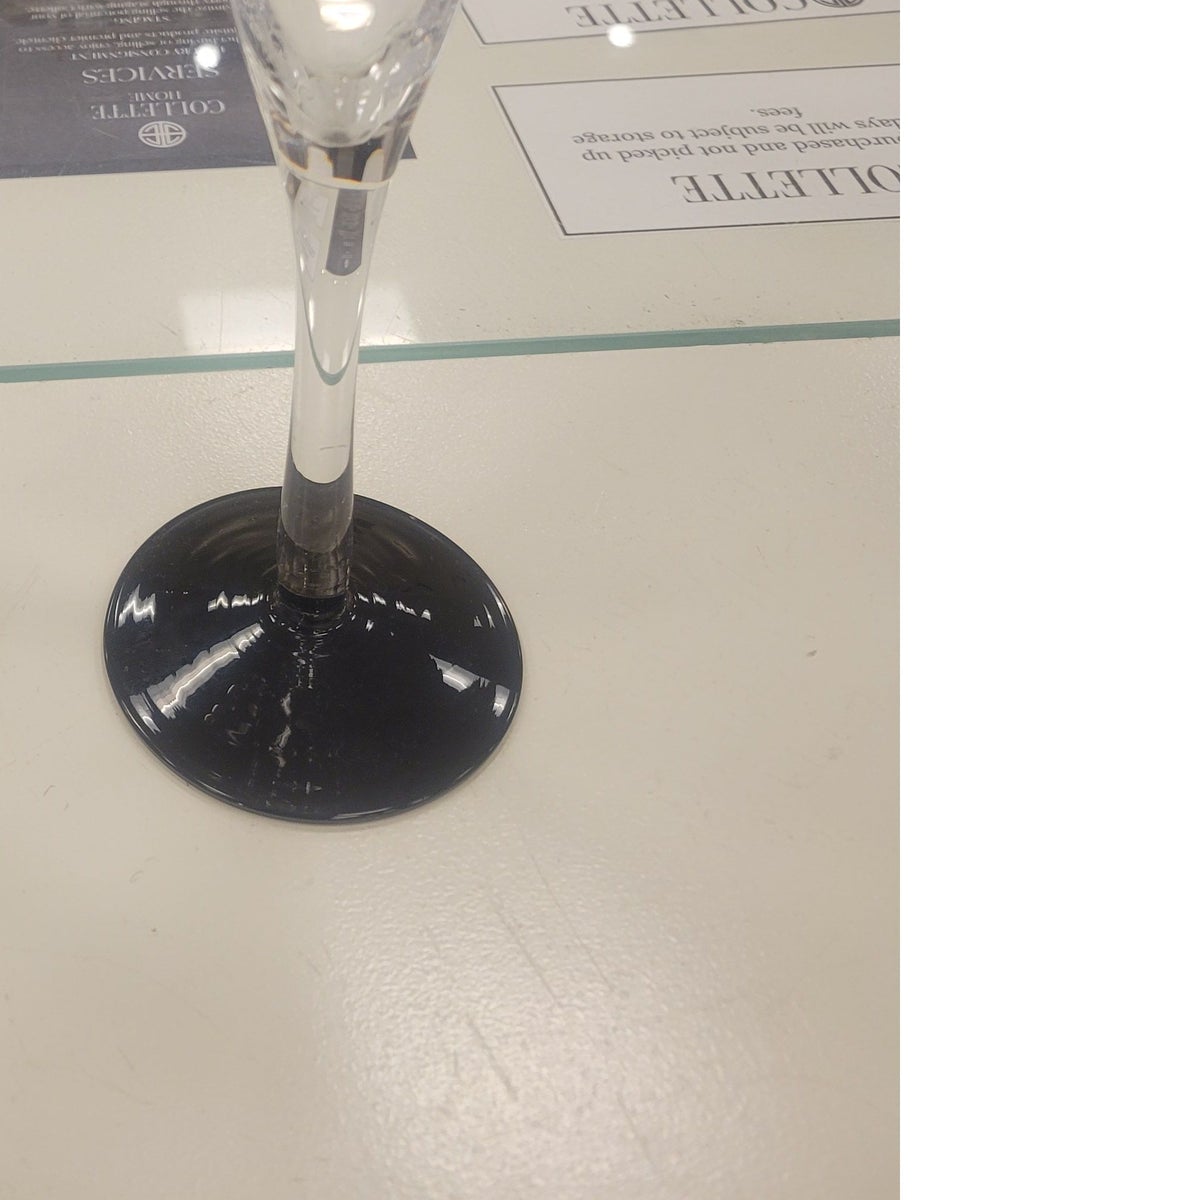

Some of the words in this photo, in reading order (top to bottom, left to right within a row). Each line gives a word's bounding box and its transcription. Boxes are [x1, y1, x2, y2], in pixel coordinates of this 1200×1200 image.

[113, 16, 170, 24] STAGING
[69, 32, 117, 42] premier
[119, 32, 140, 42] and
[143, 28, 199, 40] products
[70, 48, 169, 60] CONSIGNMENT
[81, 64, 220, 84] SERVICES
[128, 90, 182, 102] HOME
[90, 100, 226, 120] COLLETTE
[750, 106, 803, 120] fees.
[689, 124, 769, 142] subject
[774, 123, 803, 137] be
[807, 121, 849, 134] will
[572, 131, 654, 148] storage
[660, 130, 684, 143] to
[794, 134, 900, 153] urchased
[618, 145, 695, 163] picked
[699, 144, 738, 159] not
[744, 141, 788, 156] and
[581, 148, 612, 164] up
[670, 164, 900, 203] OLLETTE
